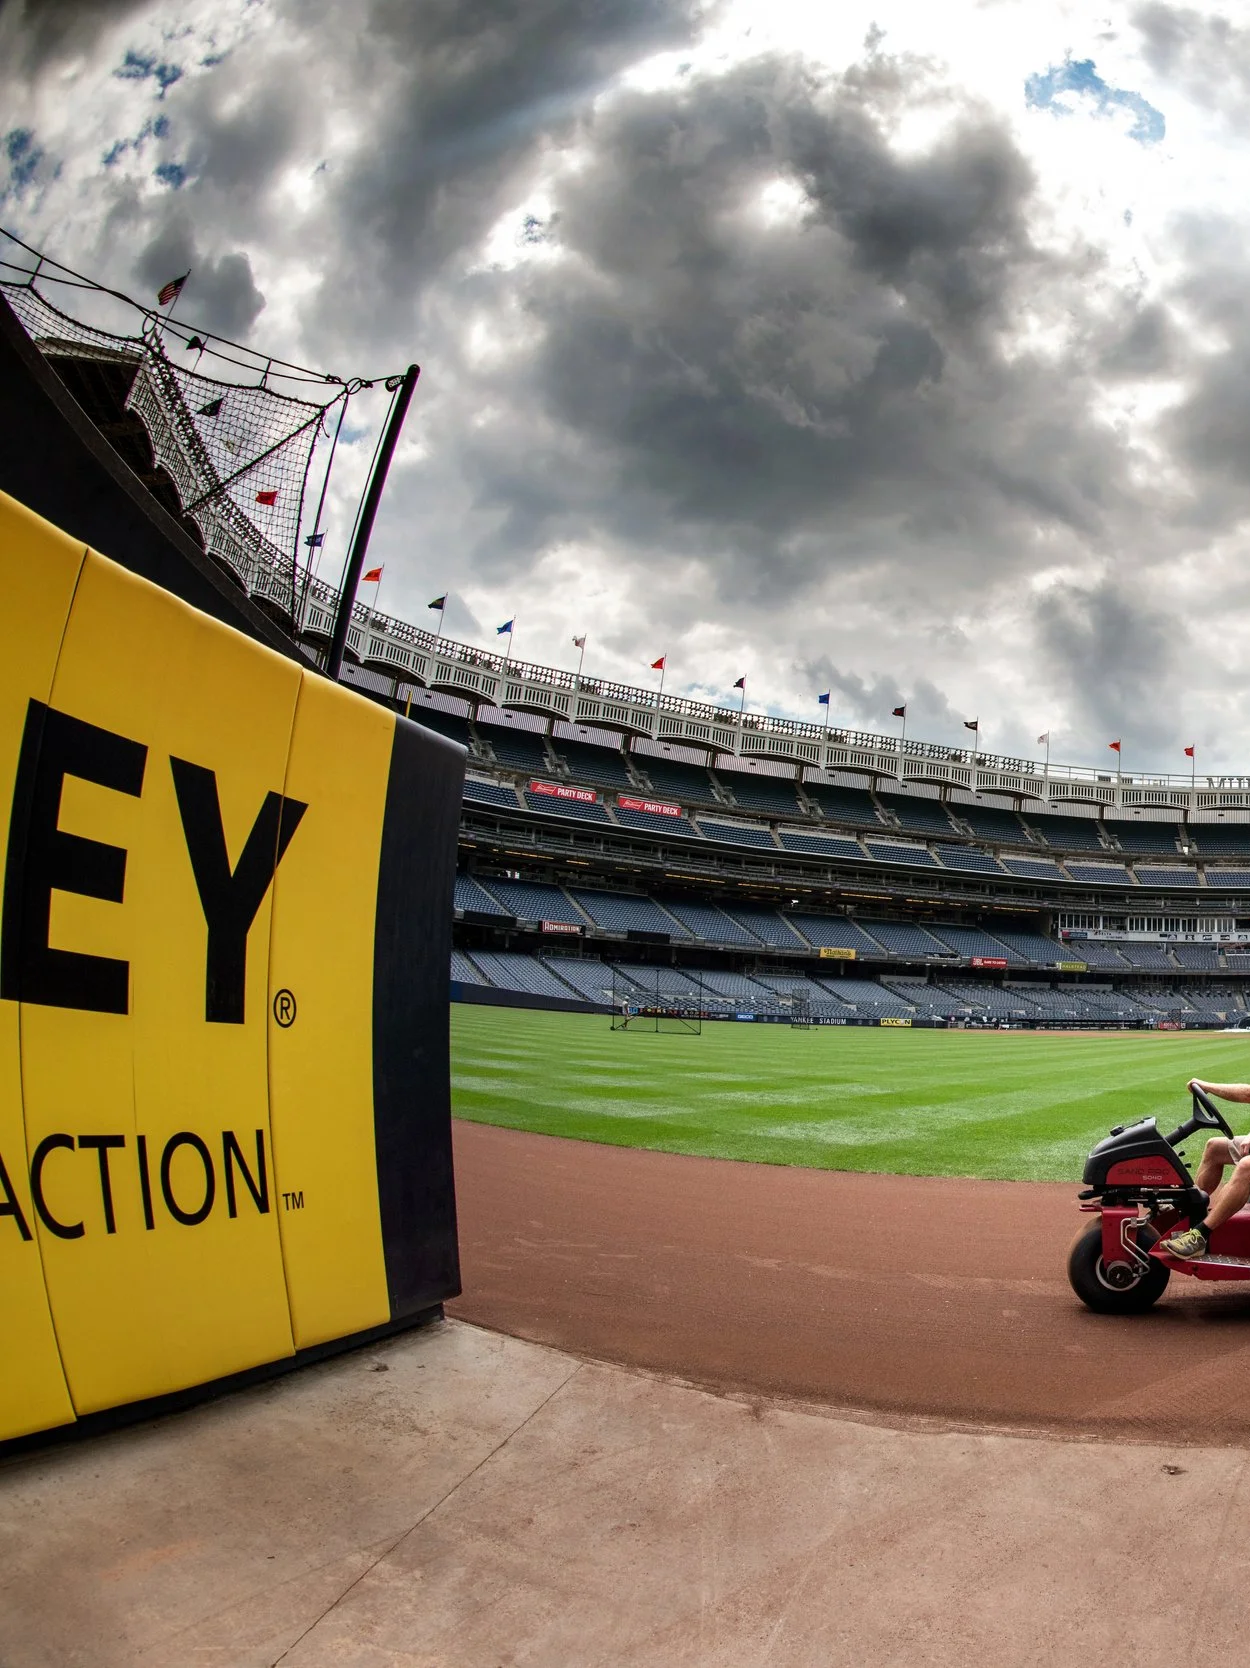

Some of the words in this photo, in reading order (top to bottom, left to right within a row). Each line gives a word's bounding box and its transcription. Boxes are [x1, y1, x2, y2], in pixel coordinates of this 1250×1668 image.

[557, 787, 577, 799] PARTY
[577, 791, 593, 801] DECK
[644, 803, 662, 813] PARTY
[662, 806, 679, 816] DECK
[0, 697, 309, 1025] EY
[819, 1017, 847, 1025] STADIUM
